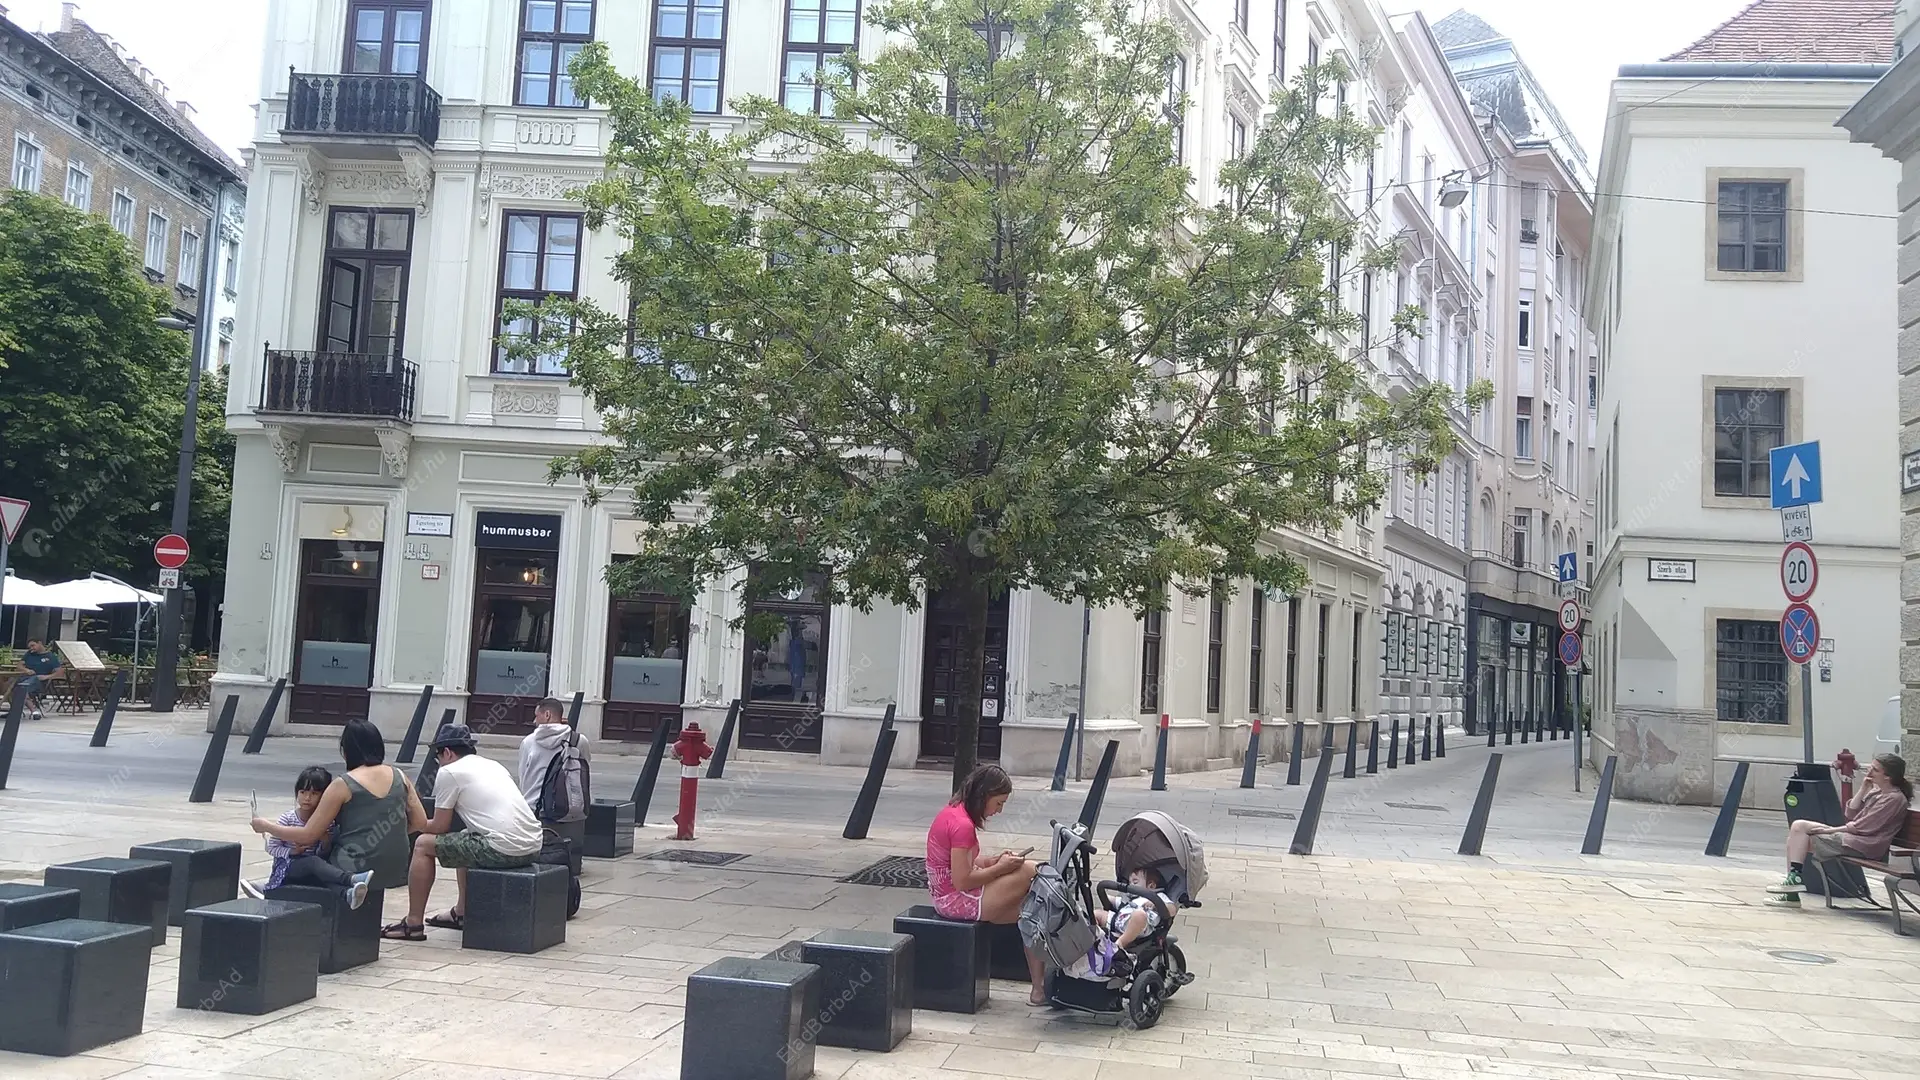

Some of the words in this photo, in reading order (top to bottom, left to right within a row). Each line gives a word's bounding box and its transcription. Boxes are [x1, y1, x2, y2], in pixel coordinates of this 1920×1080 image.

[1784, 507, 1808, 520] KIVÉVE
[482, 524, 552, 538] hummusbar
[1788, 560, 1807, 584] 20
[1564, 609, 1576, 623] 20
